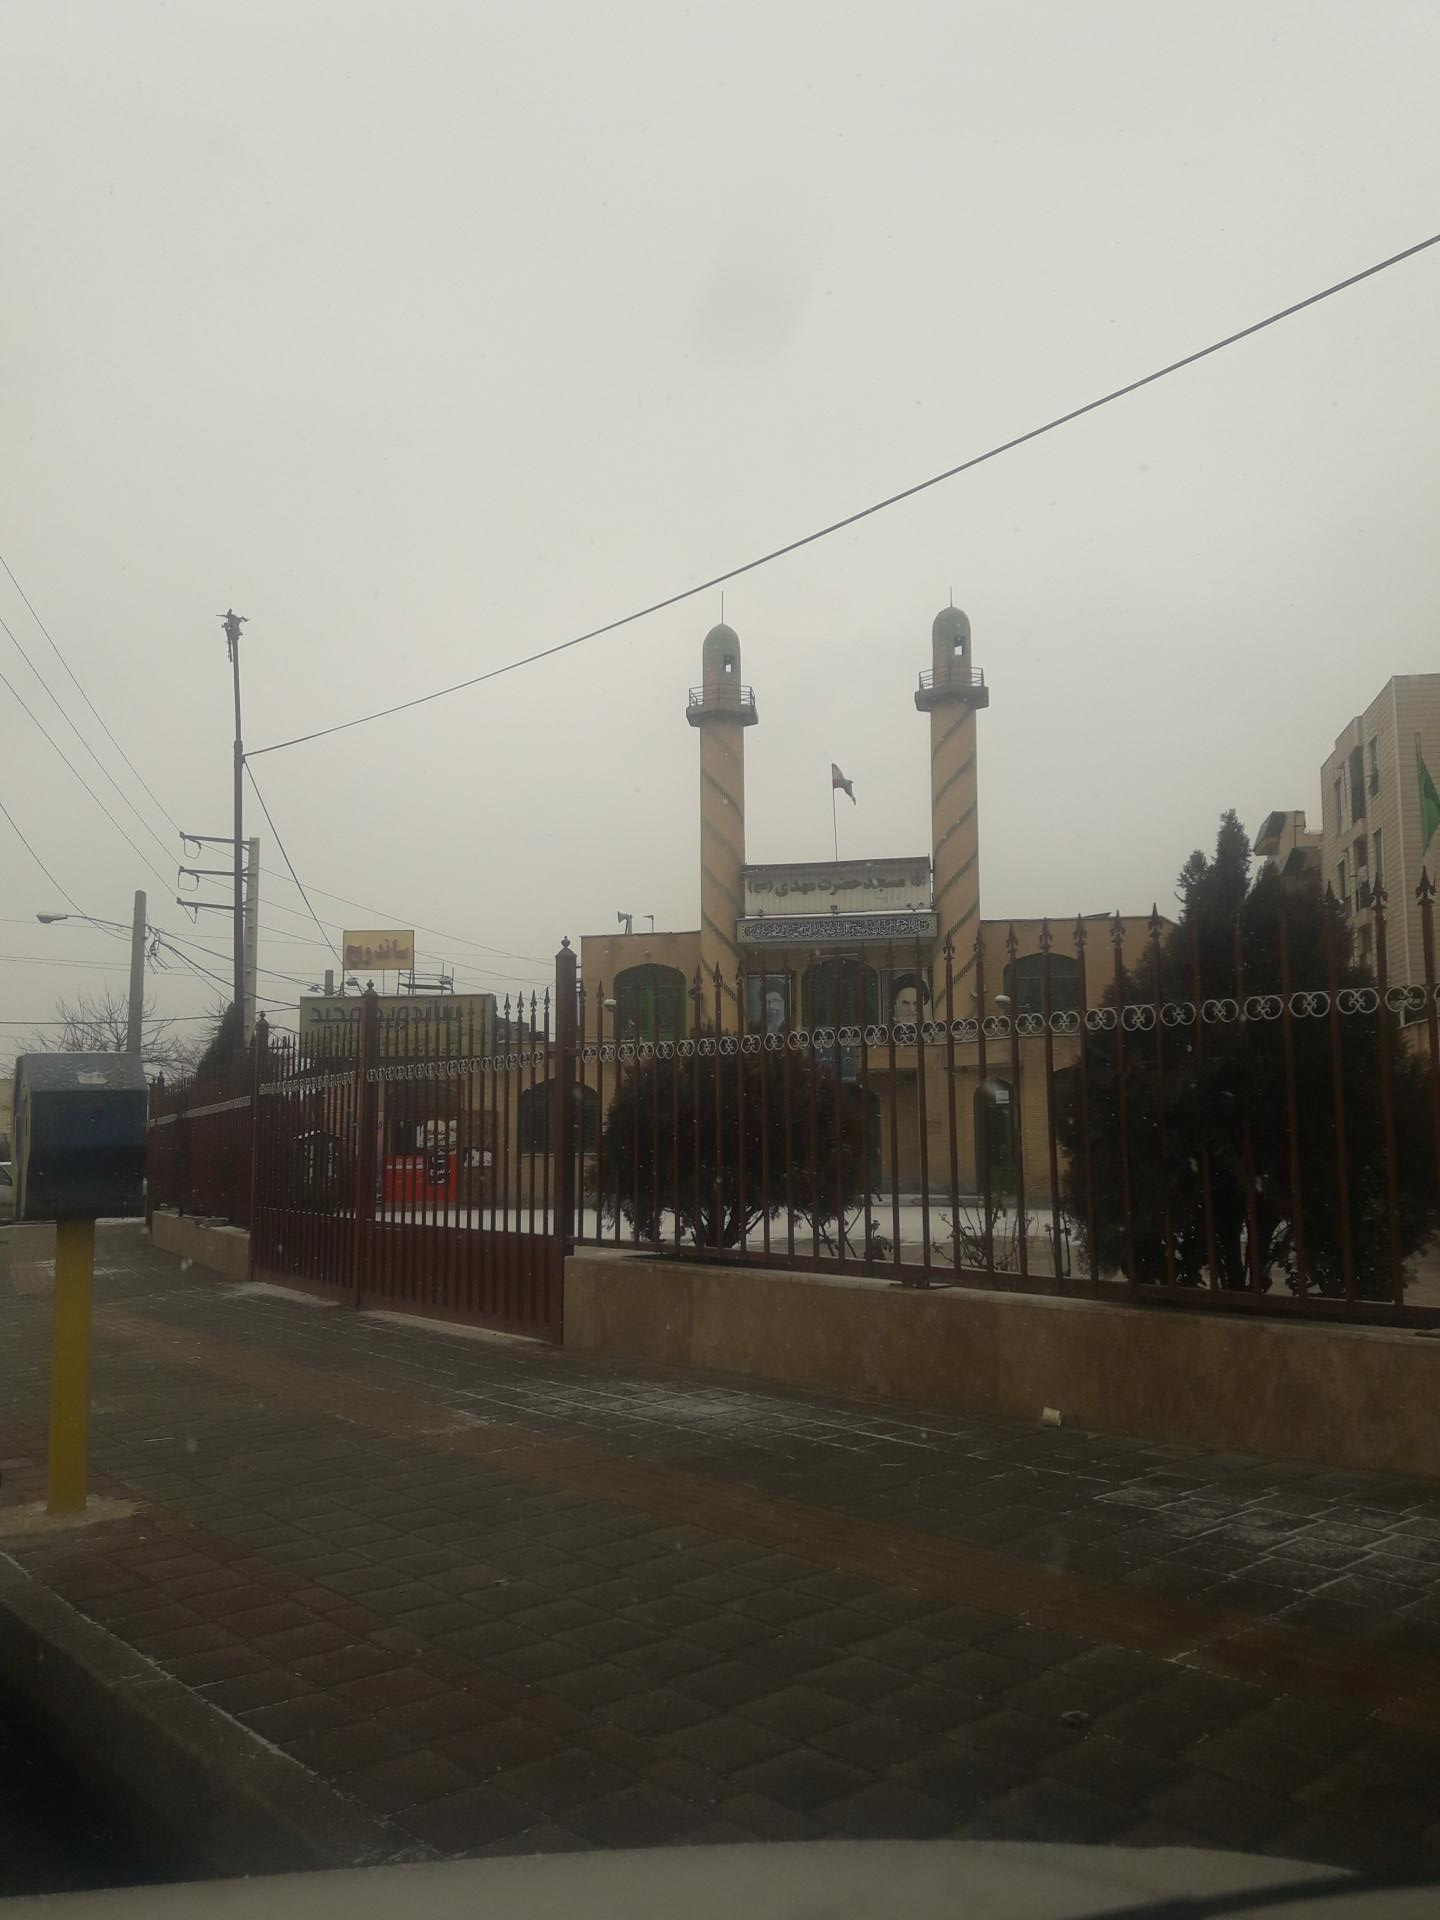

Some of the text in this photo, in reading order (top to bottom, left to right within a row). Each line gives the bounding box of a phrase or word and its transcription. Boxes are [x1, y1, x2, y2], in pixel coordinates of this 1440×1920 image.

[776, 879, 817, 898] مهدی
[817, 878, 862, 896] حضرت
[864, 877, 906, 892] مسجد
